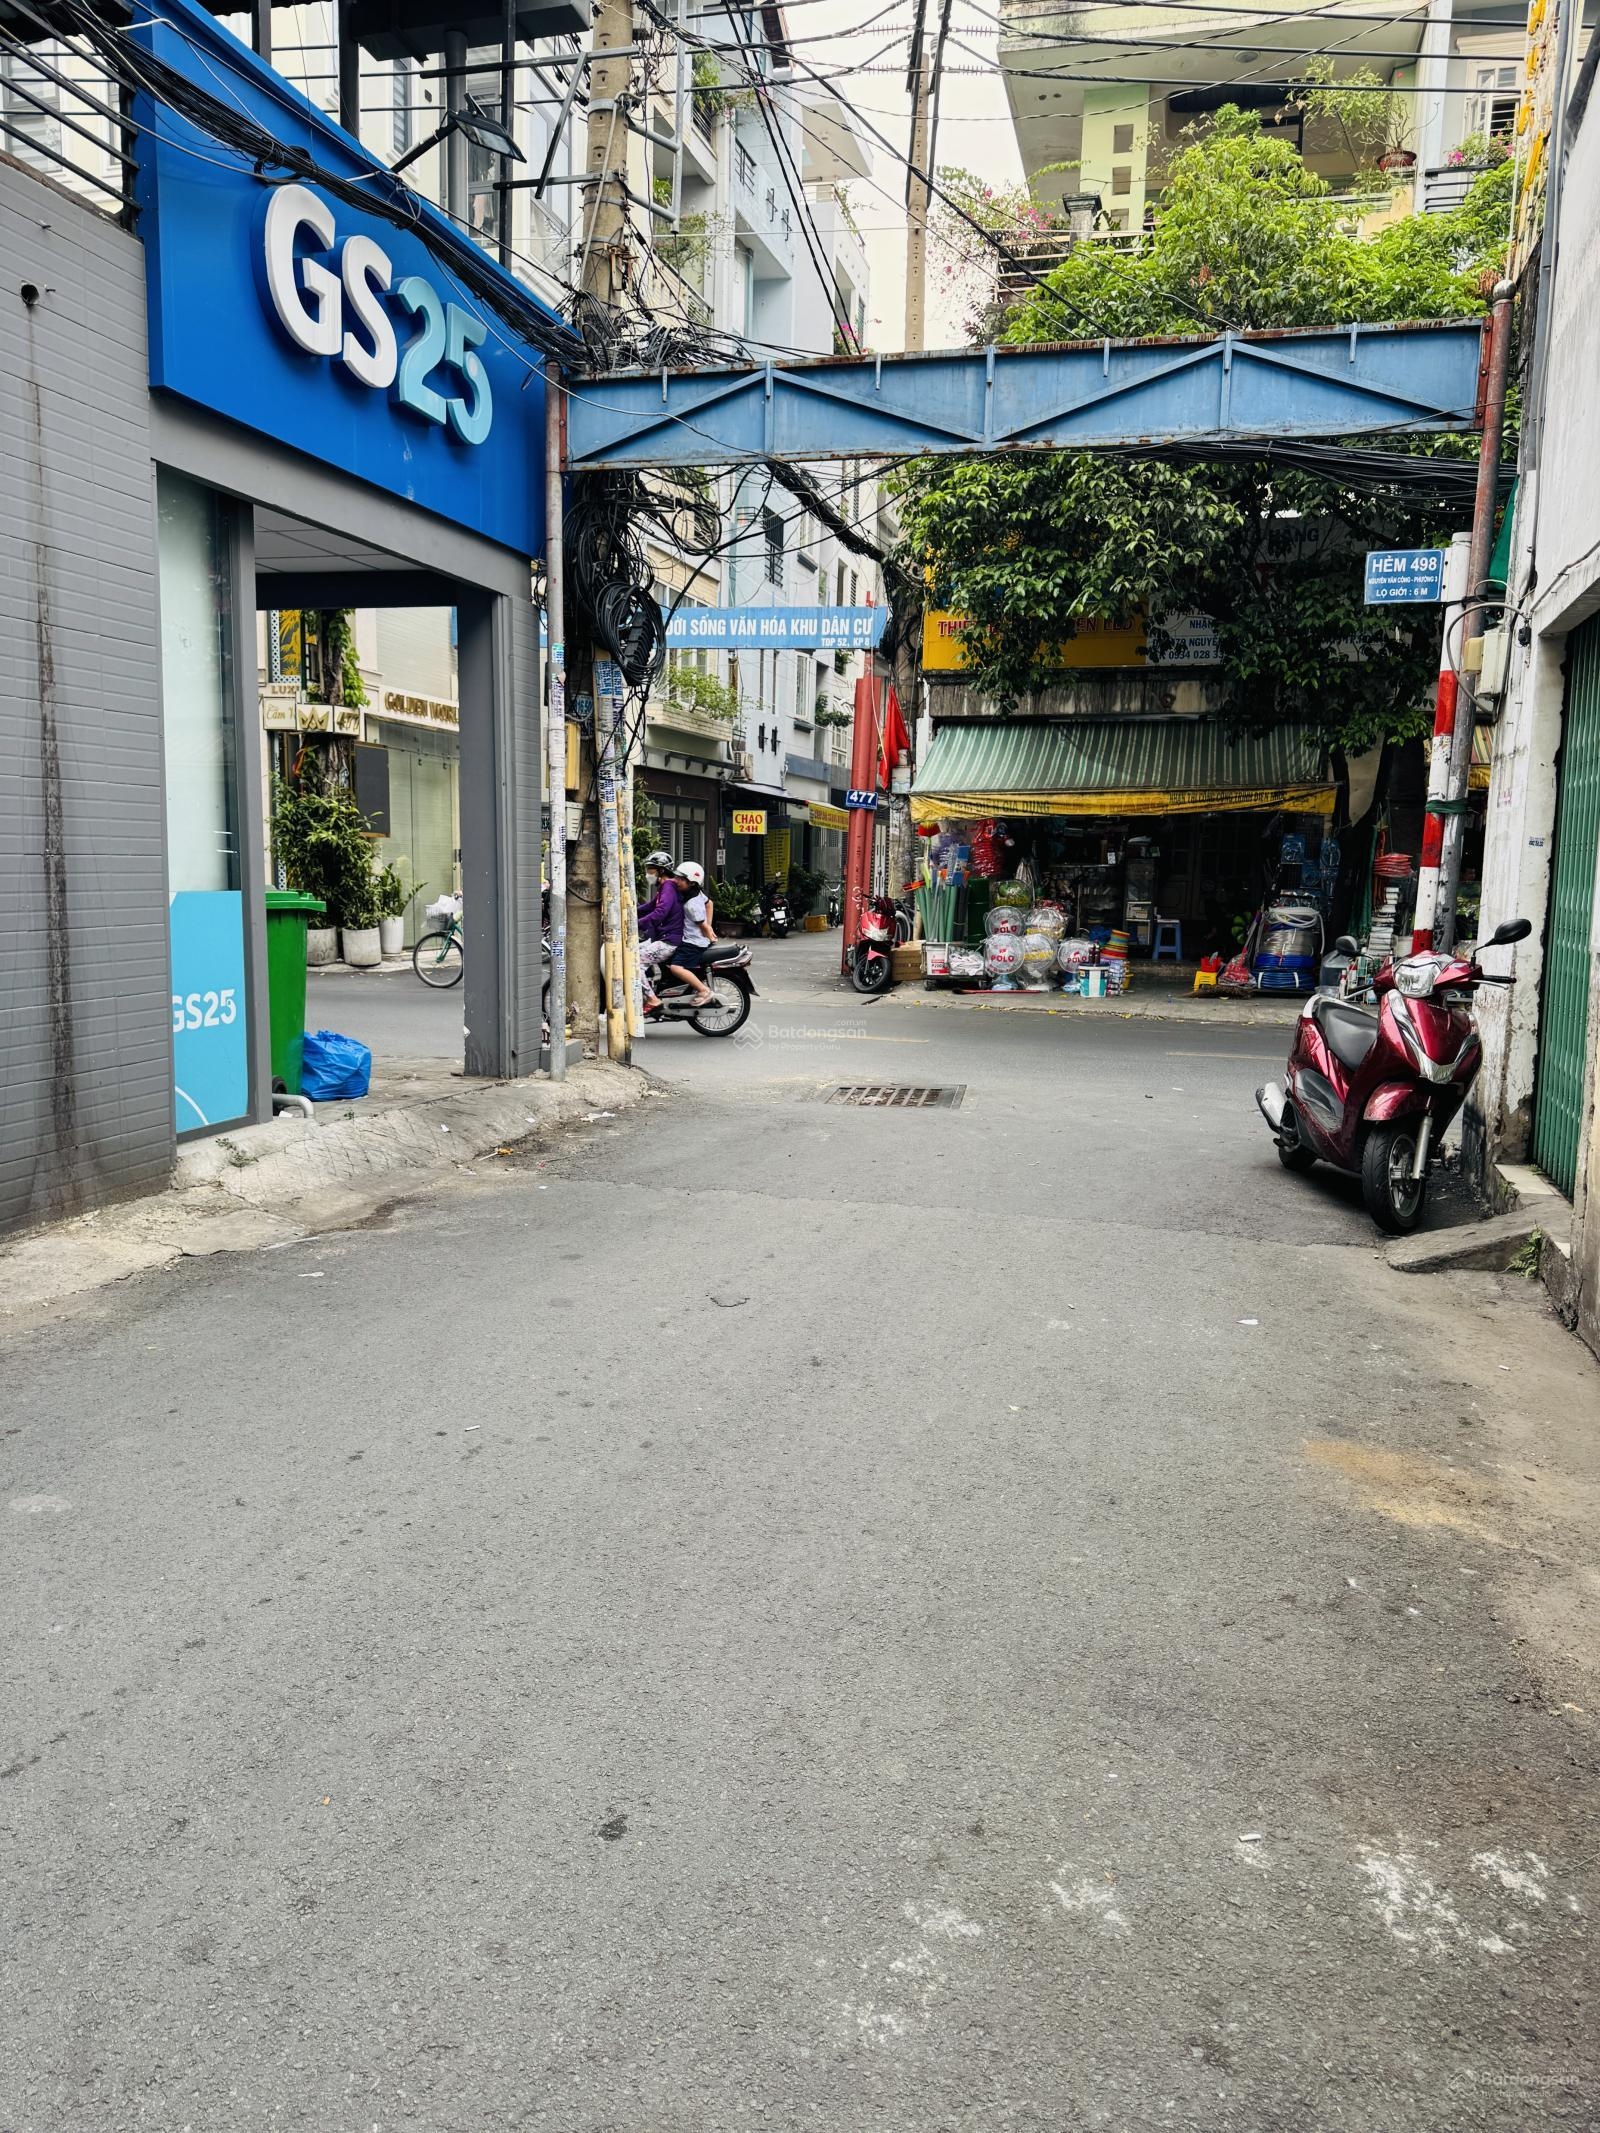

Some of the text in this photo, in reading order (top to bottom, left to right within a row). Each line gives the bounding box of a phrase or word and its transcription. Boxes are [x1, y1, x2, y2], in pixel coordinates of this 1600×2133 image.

[265, 183, 493, 445] GS25
[1410, 556, 1437, 572] 498
[1413, 588, 1419, 596] 6
[1420, 587, 1428, 595] M
[690, 613, 726, 636] SỐNG
[730, 615, 757, 636] VĂN
[760, 615, 787, 637] HÓA
[790, 618, 818, 636] KHU
[821, 615, 850, 636] DÂN
[853, 615, 874, 636] CƯ
[853, 637, 864, 647] KP
[1193, 650, 1210, 659] 028
[849, 791, 876, 804] 477
[739, 825, 758, 833] 24H
[993, 924, 1018, 934] POLO
[990, 954, 1015, 963] POLO
[1067, 955, 1087, 964] POLO
[172, 988, 237, 1033] GS25
